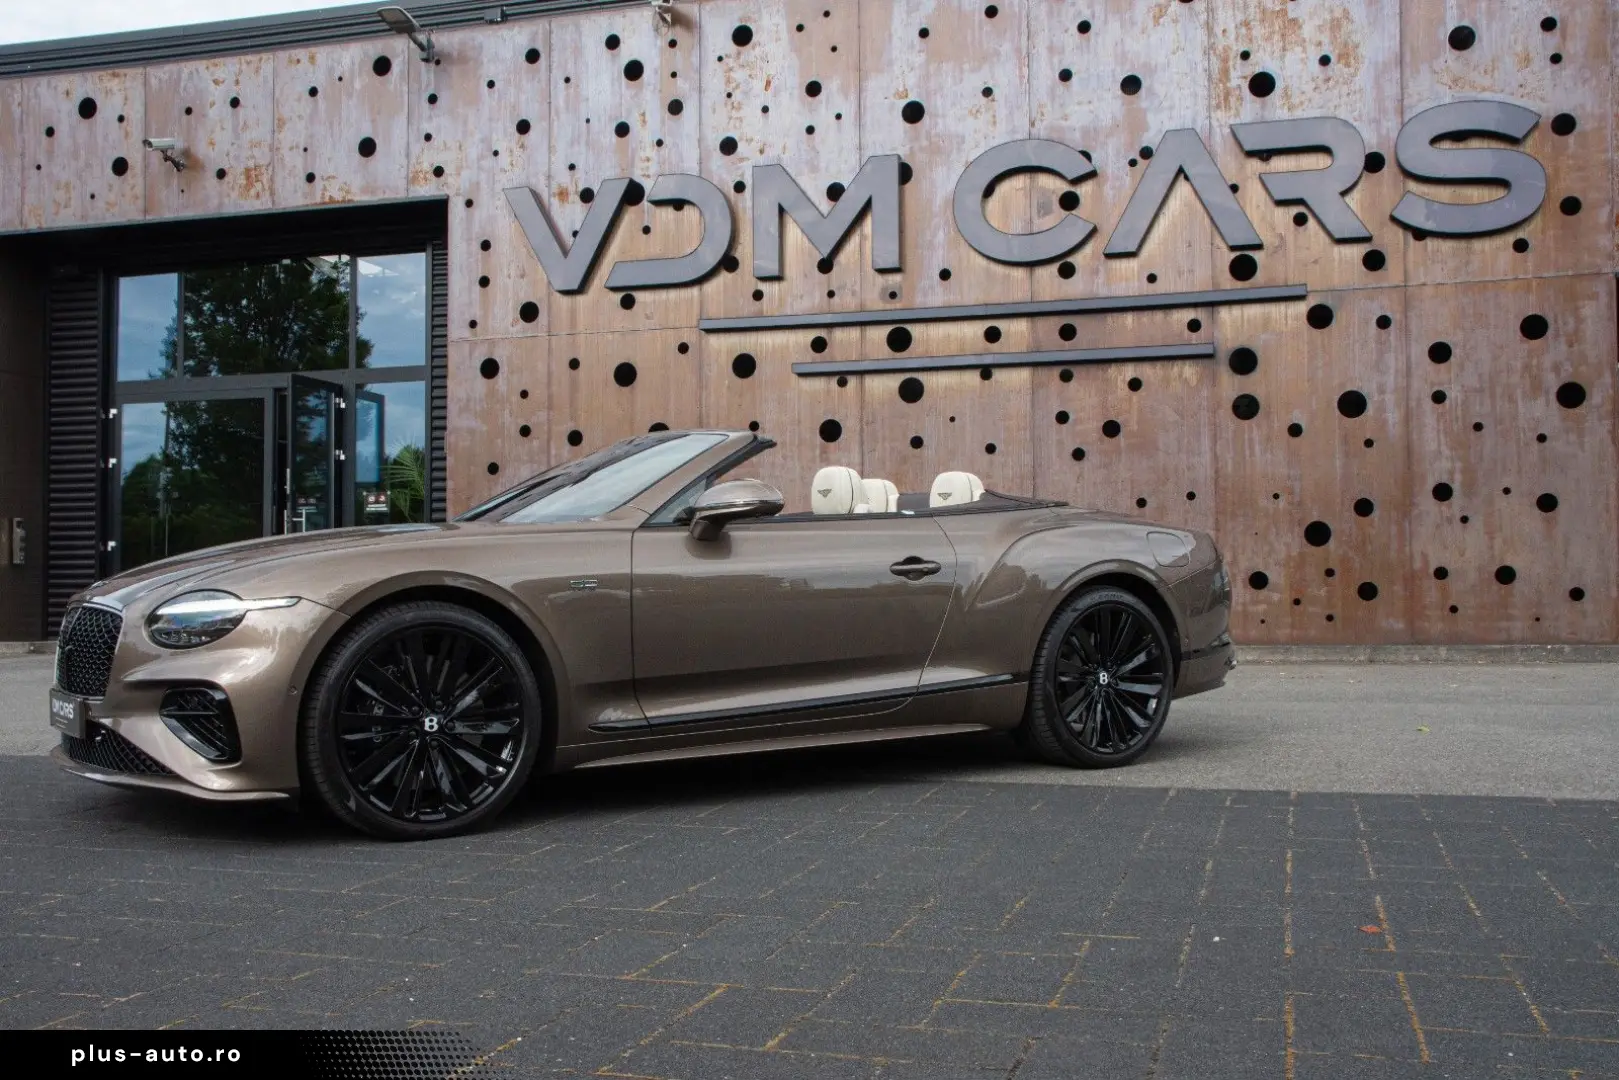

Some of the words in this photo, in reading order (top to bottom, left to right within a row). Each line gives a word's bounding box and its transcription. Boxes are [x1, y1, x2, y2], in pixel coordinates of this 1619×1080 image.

[502, 154, 903, 295] VDM
[952, 100, 1547, 267] CARS
[424, 716, 439, 732] B
